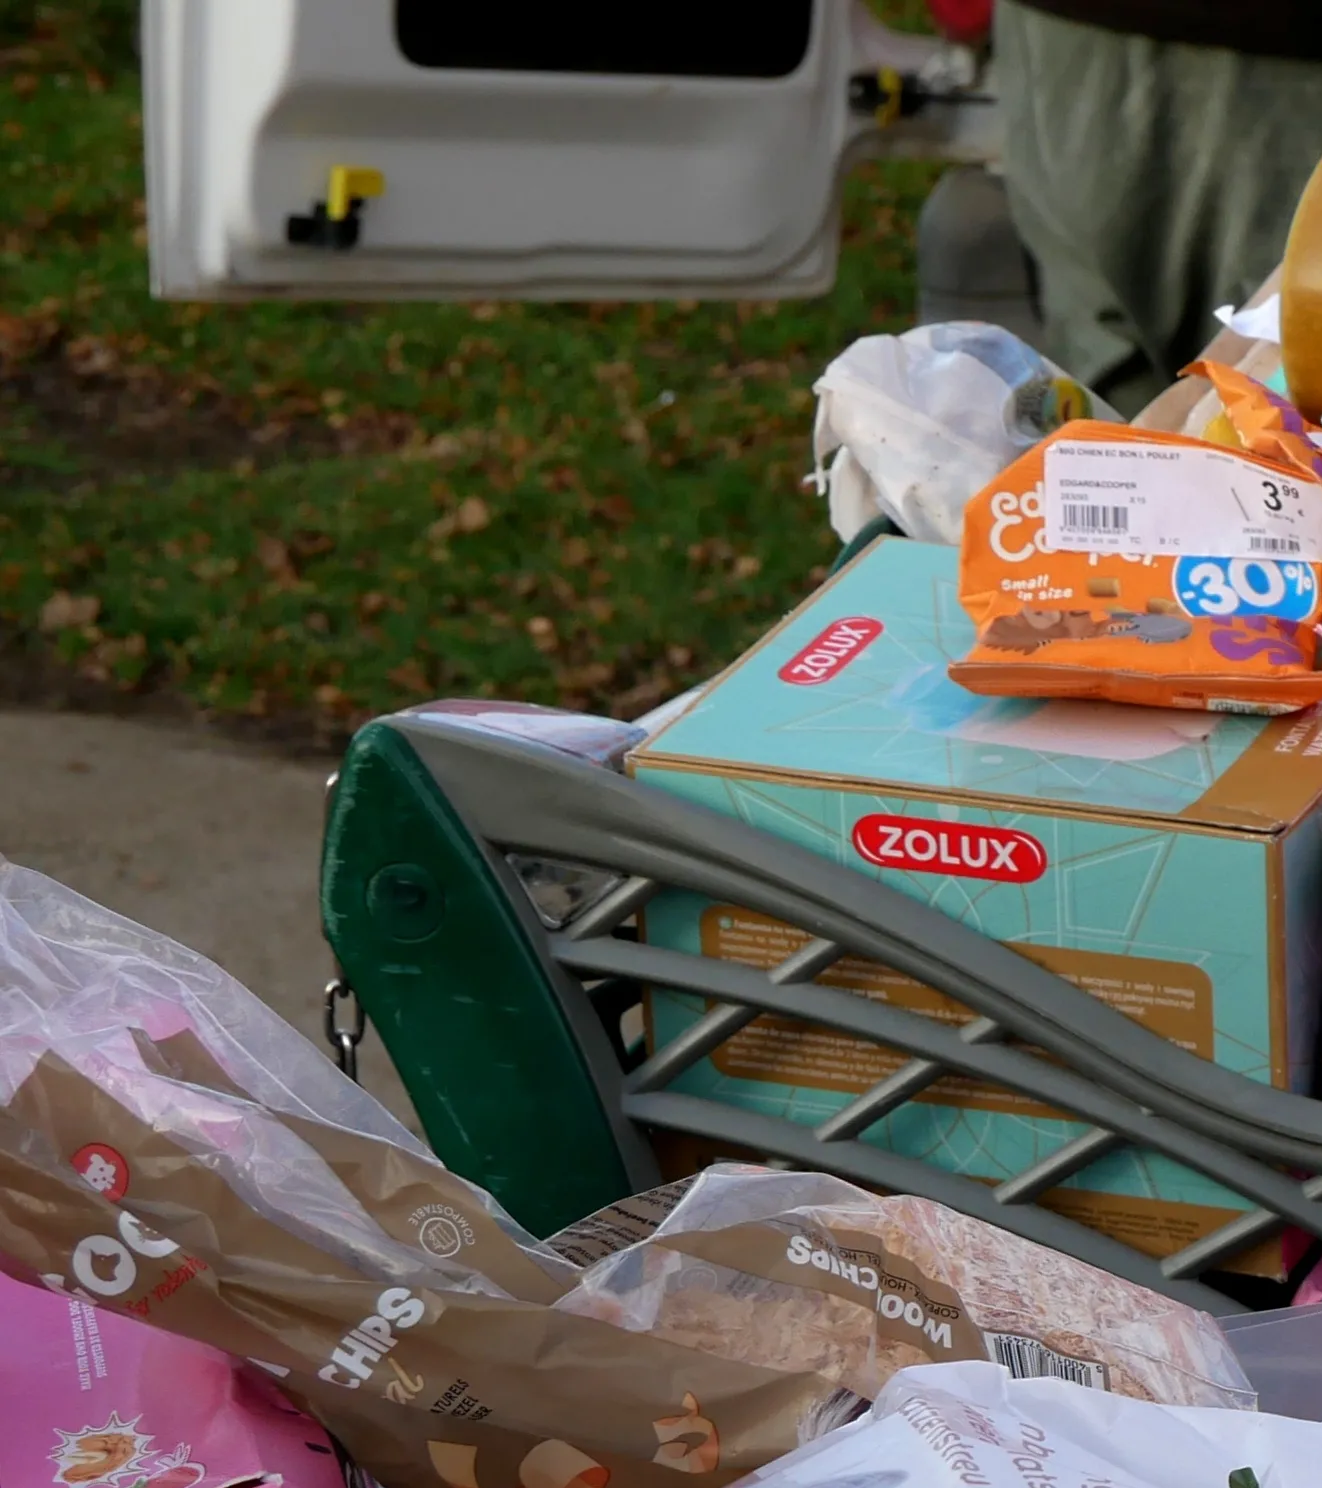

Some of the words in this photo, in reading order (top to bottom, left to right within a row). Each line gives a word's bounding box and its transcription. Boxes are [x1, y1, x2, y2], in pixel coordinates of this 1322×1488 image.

[1262, 481, 1282, 511] 3
[1282, 485, 1300, 499] 99
[1001, 574, 1049, 591] Small
[1017, 588, 1034, 601] in
[1038, 586, 1073, 600] size
[792, 624, 871, 680] ZOLUX
[878, 826, 1019, 872] ZOLUX
[407, 1203, 476, 1247] COMPOSTABLE
[787, 1235, 878, 1291] CHIPS
[318, 1286, 425, 1390] CHIPS
